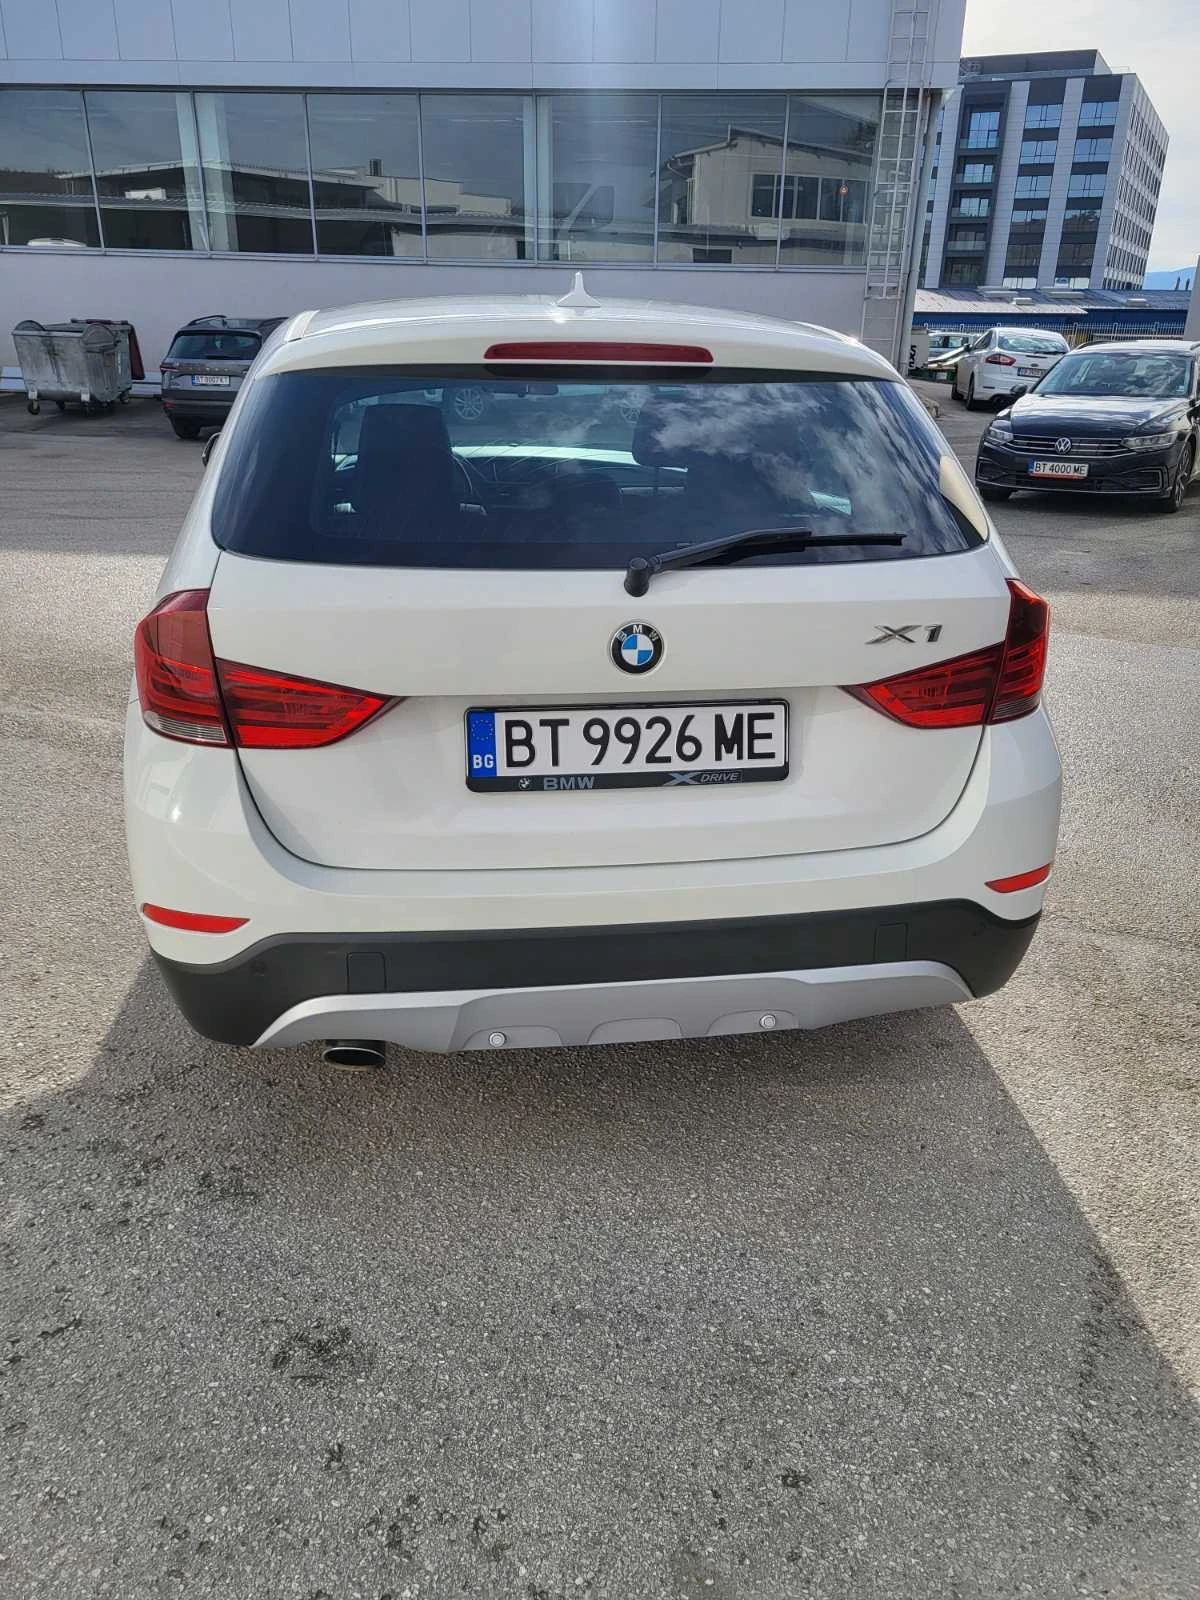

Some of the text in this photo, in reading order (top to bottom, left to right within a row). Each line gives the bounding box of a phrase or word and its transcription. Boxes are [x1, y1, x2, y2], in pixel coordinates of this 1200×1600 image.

[1035, 463, 1086, 475] BT 4000 ME
[615, 624, 659, 642] BMW
[865, 624, 943, 645] X1
[505, 712, 776, 768] BT 9926 ME
[473, 754, 494, 769] BG
[543, 776, 595, 790] BMW
